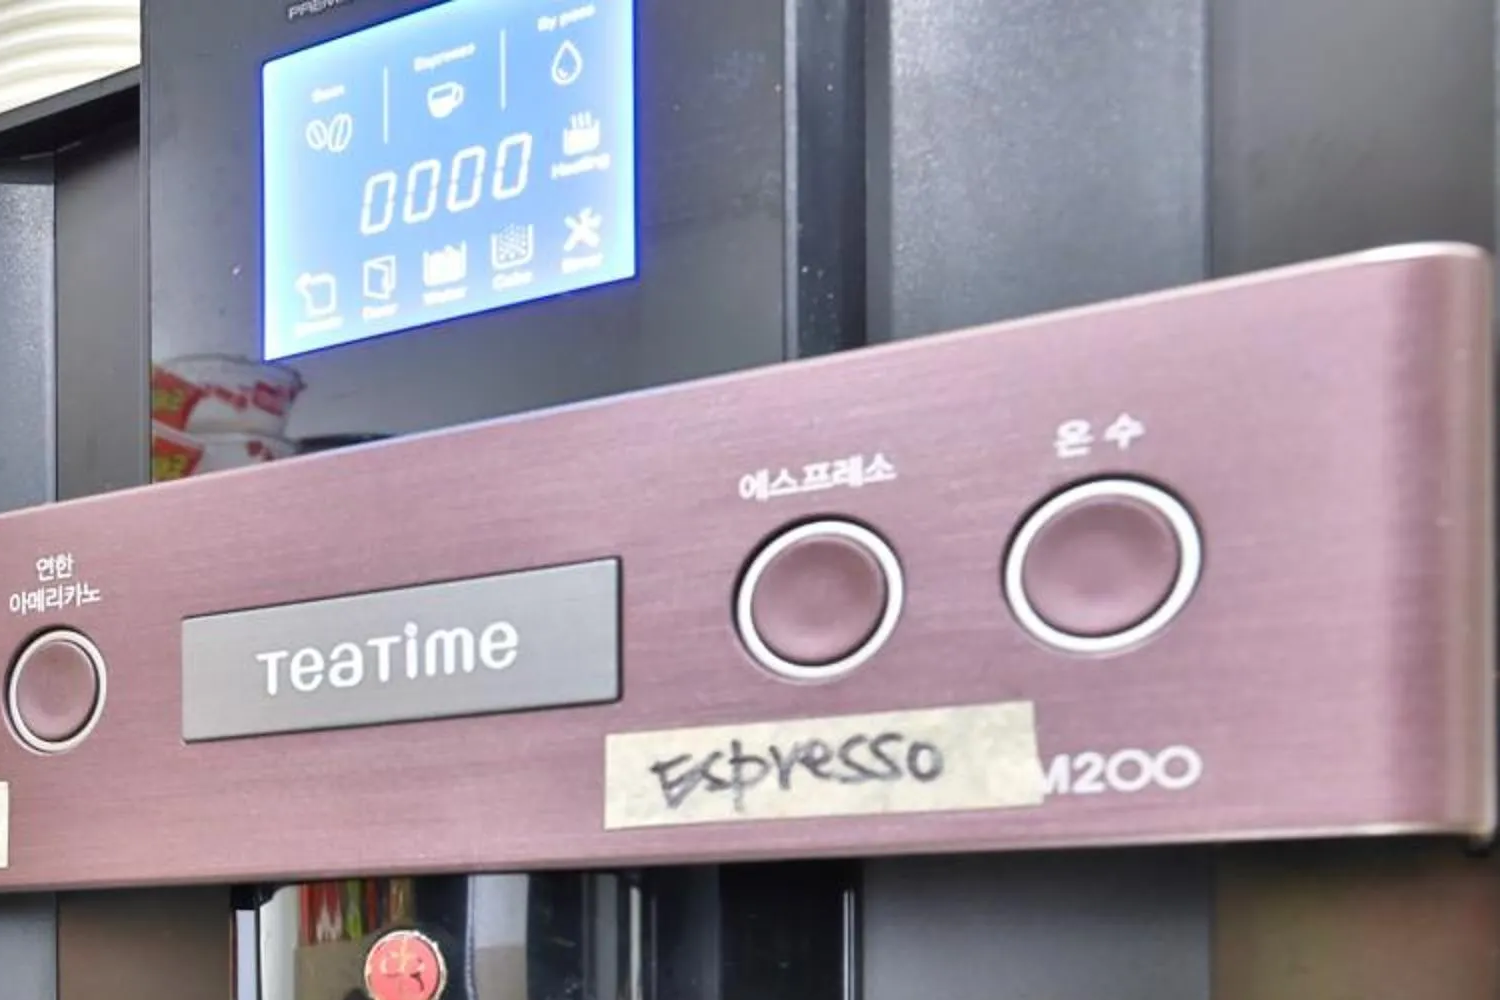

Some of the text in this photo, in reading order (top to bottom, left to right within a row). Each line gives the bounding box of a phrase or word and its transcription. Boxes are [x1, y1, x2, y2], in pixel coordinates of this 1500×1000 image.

[360, 132, 533, 236] 0000
[738, 452, 897, 502] 에스프레소
[35, 553, 75, 582] 연한
[9, 583, 101, 616] 아메리카노
[650, 732, 945, 811] Espresso
